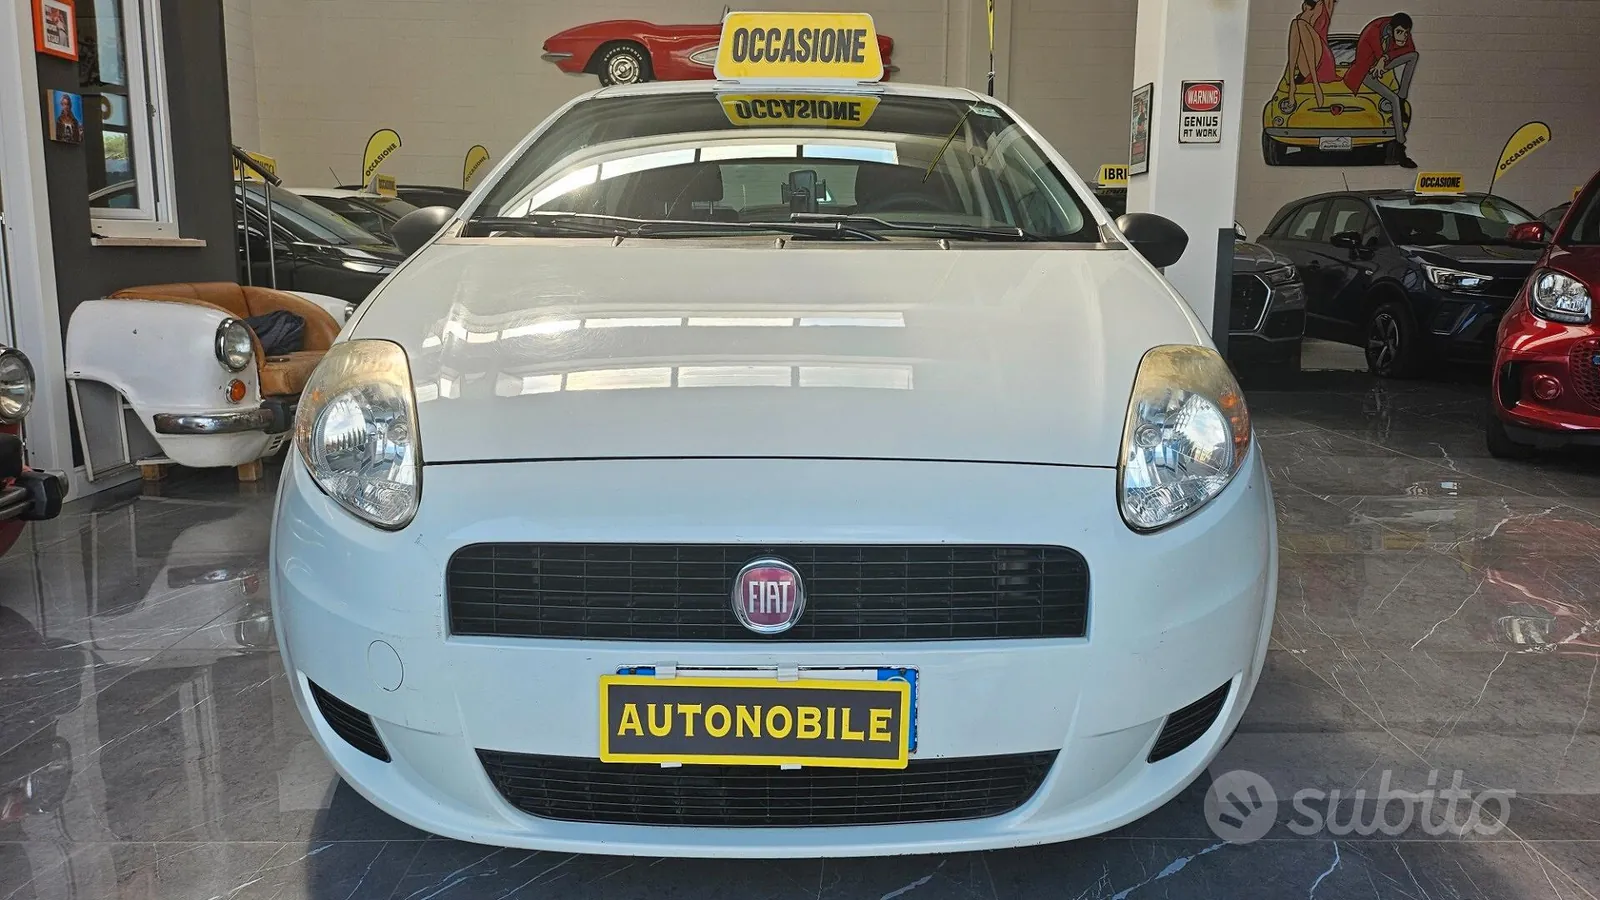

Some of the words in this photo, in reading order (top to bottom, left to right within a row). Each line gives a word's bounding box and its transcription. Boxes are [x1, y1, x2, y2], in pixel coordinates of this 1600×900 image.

[732, 28, 867, 63] OCCASIONE
[1187, 90, 1218, 104] WARNING
[1183, 129, 1193, 138] AT
[1195, 129, 1218, 138] WORK
[1184, 116, 1218, 127] GENIUS
[365, 142, 398, 177] OCCASIONE
[1500, 135, 1546, 171] OCCASIONE
[1420, 177, 1461, 188] OCCASIONE
[749, 580, 791, 614] FIAT
[617, 703, 894, 742] AUTONOBILE
